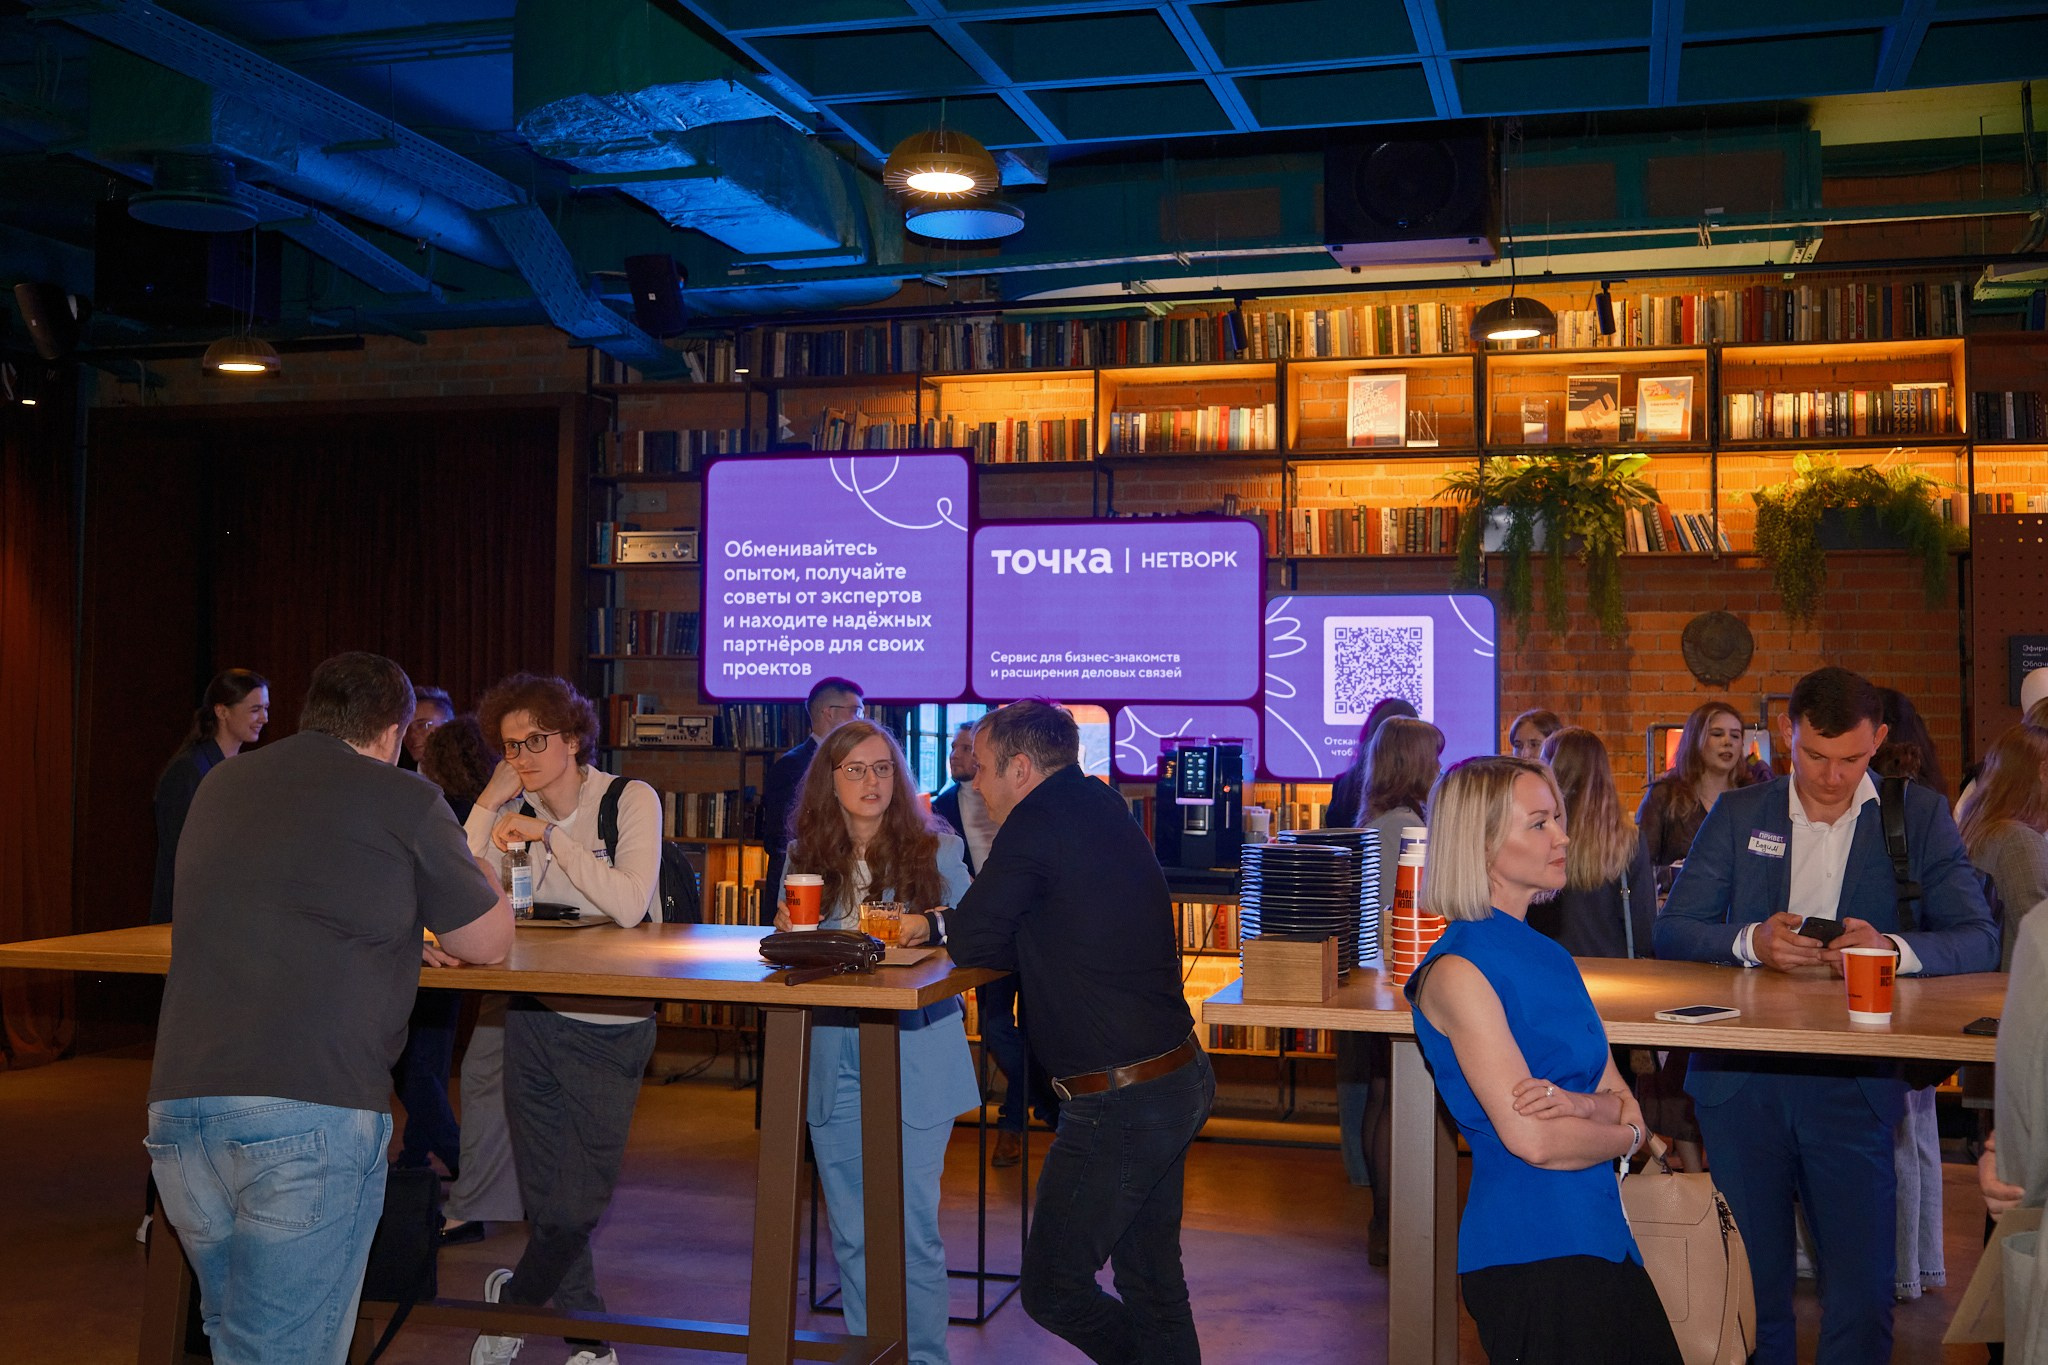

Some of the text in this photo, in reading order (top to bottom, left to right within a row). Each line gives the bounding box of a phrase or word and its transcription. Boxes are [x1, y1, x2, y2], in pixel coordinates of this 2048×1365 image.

[724, 539, 877, 557] Обменивайтесь
[991, 547, 1238, 575] точка НЕТВОРК
[724, 562, 907, 584] опытом, получайте
[723, 589, 922, 608] советы от экспертов
[723, 611, 932, 630] и находите надёжных
[723, 635, 925, 656] партнёров для своих
[990, 651, 1181, 665] Сервис для бизнес-знакомств
[722, 662, 812, 680] проектов
[990, 666, 1182, 680] и расширения деловых связей
[1759, 832, 1784, 842] ПРИВЕТ
